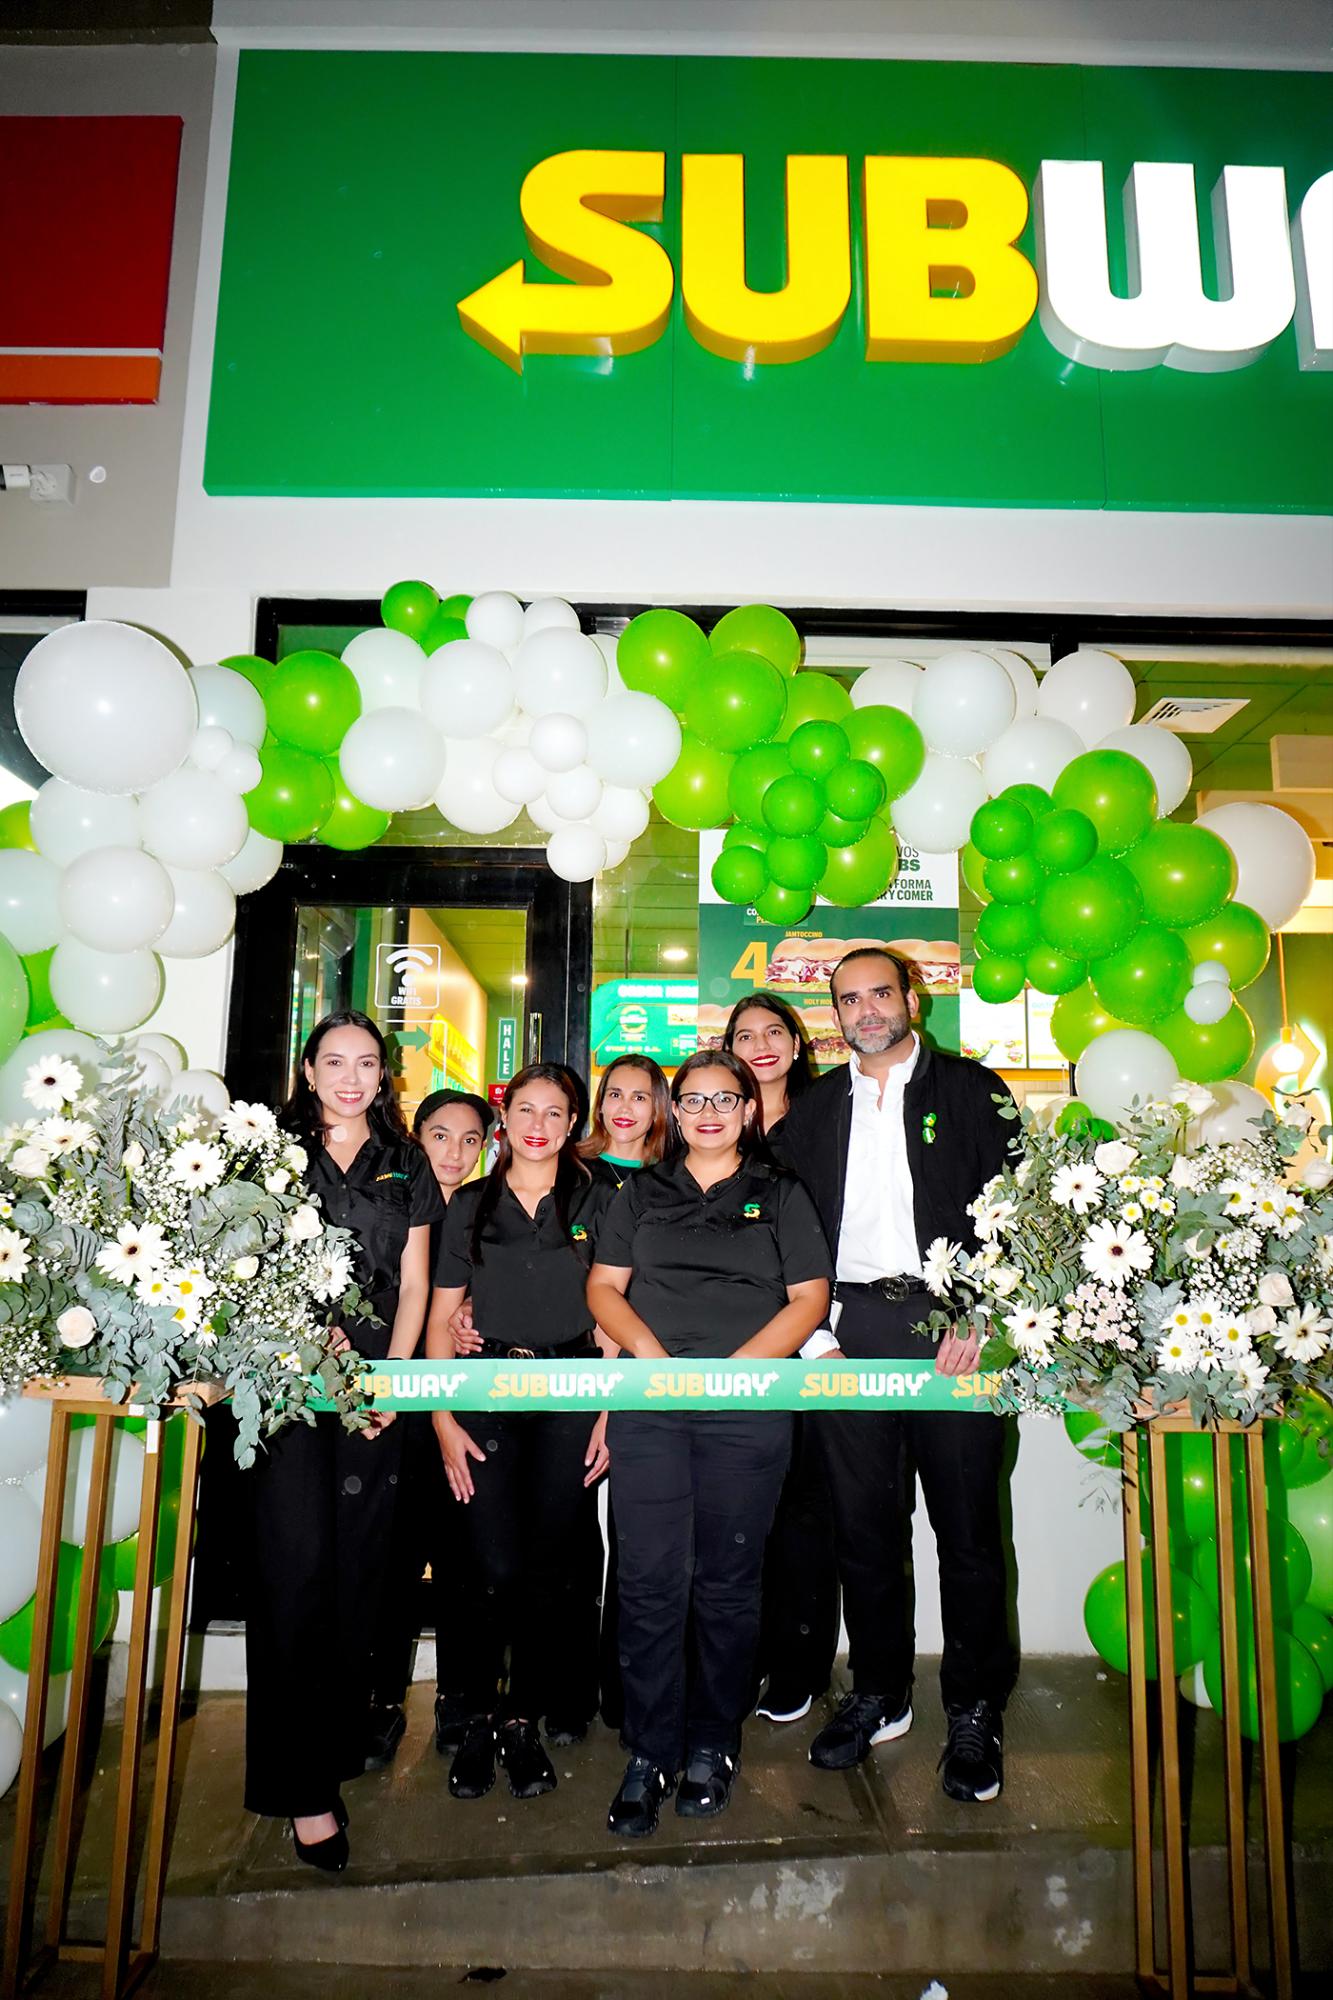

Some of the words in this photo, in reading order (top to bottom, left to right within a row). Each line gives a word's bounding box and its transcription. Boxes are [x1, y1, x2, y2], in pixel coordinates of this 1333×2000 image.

[457, 149, 1333, 373] SUBW
[894, 878, 931, 890] FORMA
[896, 889, 933, 901] COMER
[731, 941, 768, 988] 4
[390, 995, 422, 1006] GRATIS
[502, 1024, 512, 1075] HALE
[488, 1371, 625, 1399] SUBWAY
[643, 1371, 780, 1399] SUBWAY
[799, 1371, 933, 1399] SUBWAY
